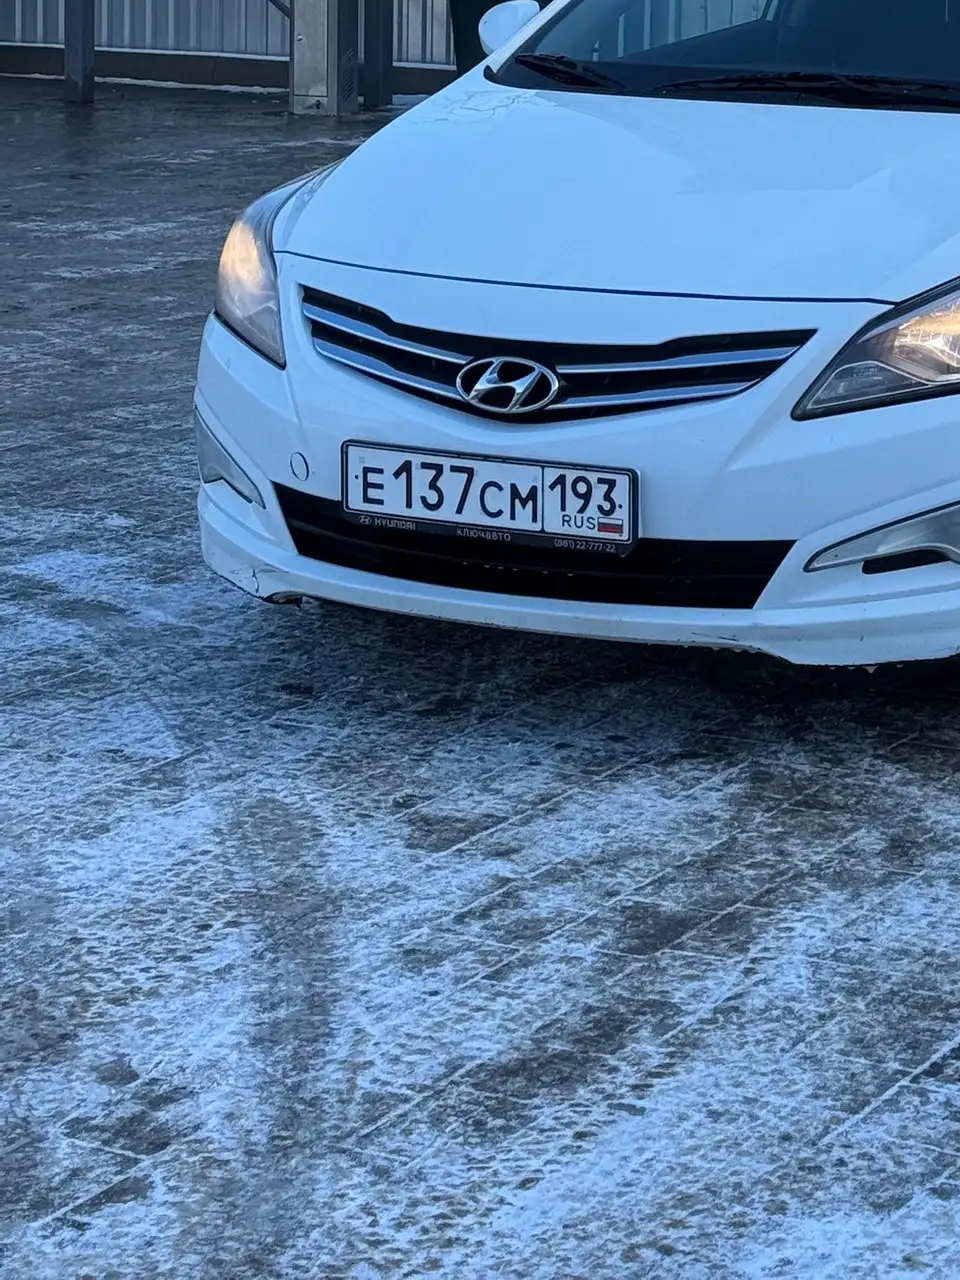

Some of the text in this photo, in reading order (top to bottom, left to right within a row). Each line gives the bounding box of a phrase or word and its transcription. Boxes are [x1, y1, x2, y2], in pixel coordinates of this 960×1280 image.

[362, 460, 538, 523] E137CM
[548, 473, 617, 517] 193
[374, 517, 416, 531] HYUNDAI
[561, 514, 597, 530] RUS
